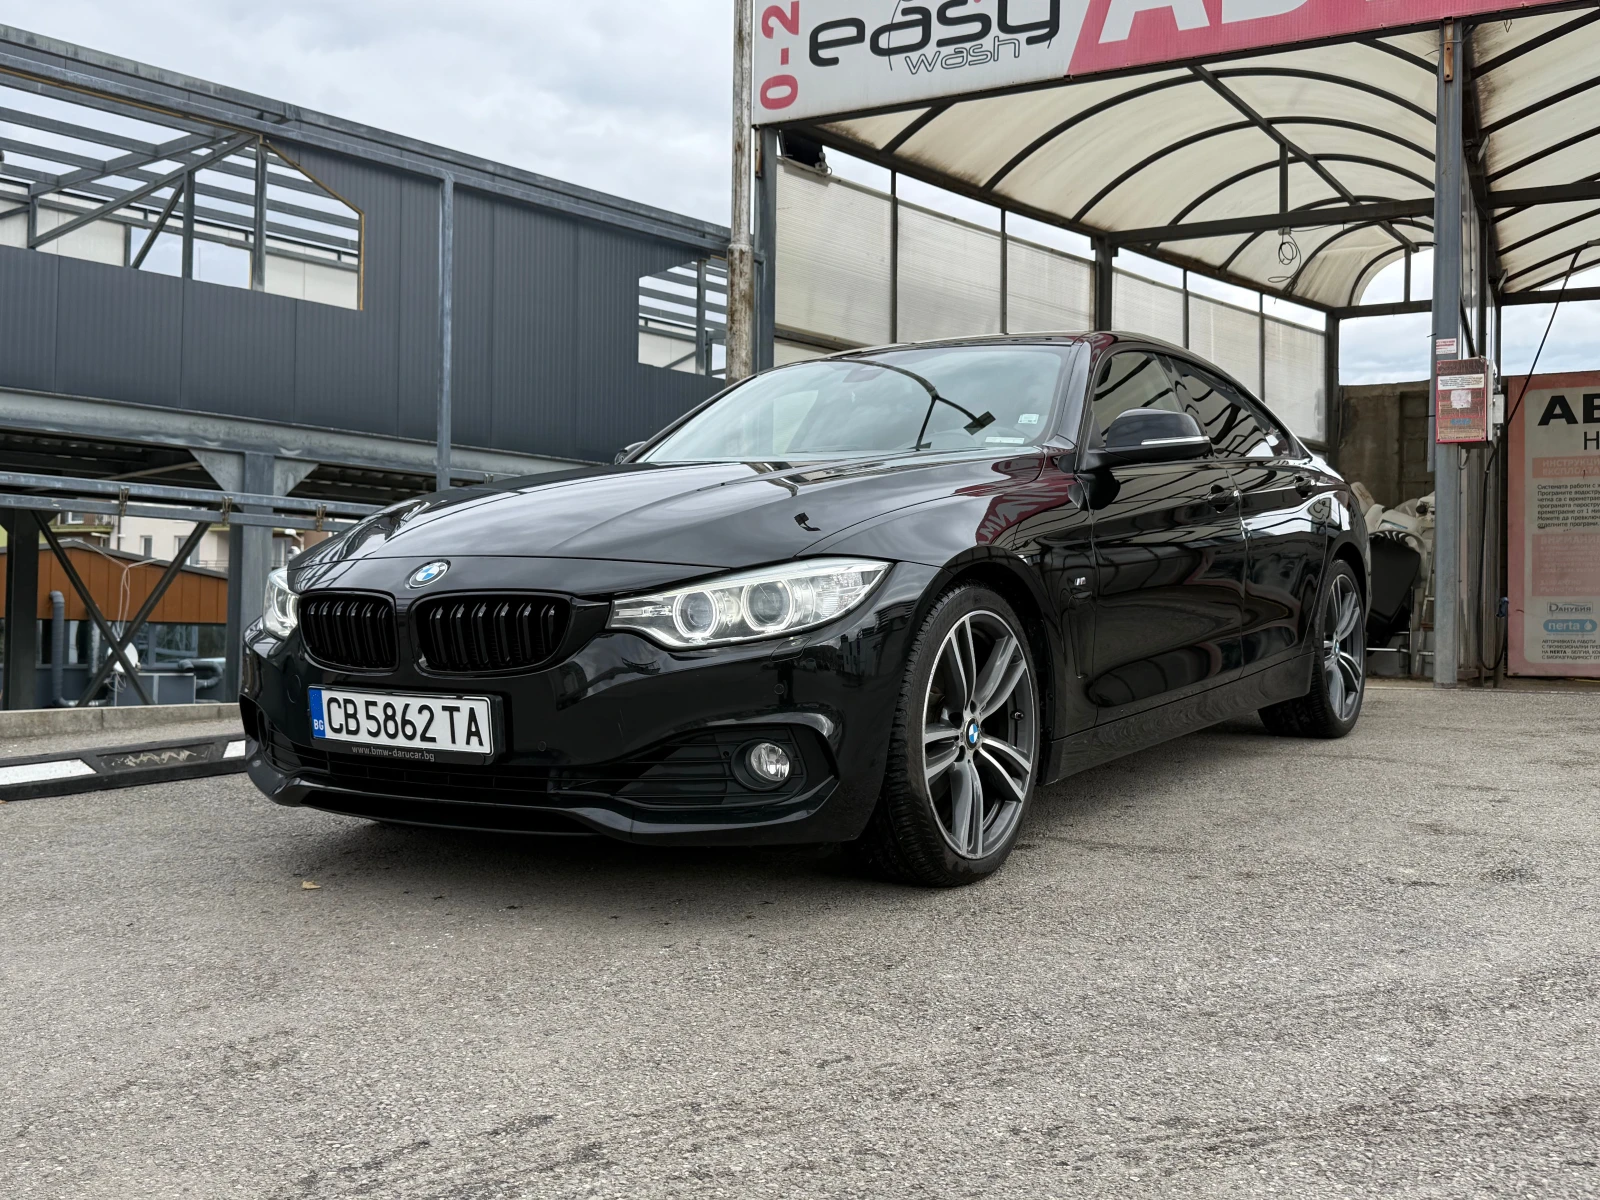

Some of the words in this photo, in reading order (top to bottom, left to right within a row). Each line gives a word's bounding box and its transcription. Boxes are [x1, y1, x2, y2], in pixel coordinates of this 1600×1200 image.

[809, 0, 1061, 67] easy
[904, 35, 1021, 75] wash
[1548, 621, 1580, 630] nerta
[313, 719, 325, 730] BG
[351, 745, 435, 761] www.bmw-darucar.bg
